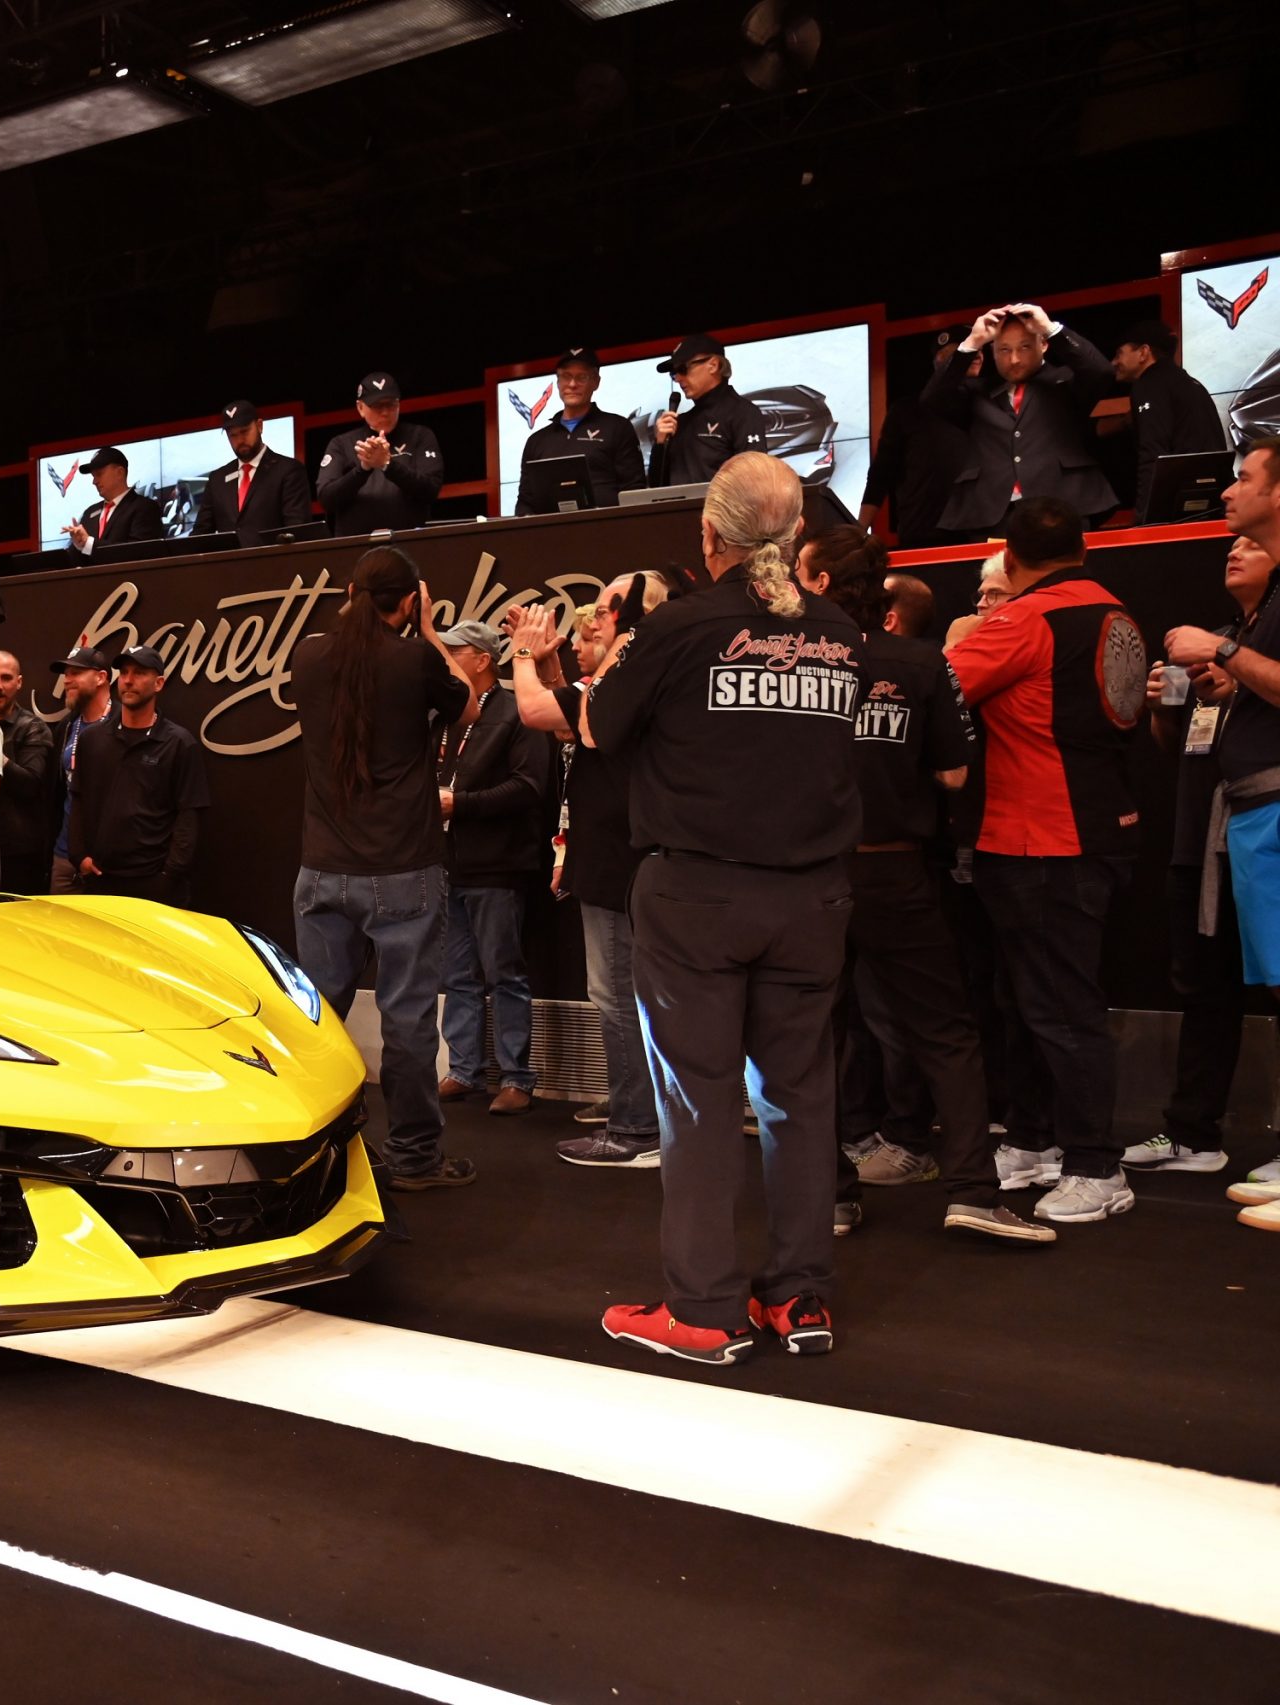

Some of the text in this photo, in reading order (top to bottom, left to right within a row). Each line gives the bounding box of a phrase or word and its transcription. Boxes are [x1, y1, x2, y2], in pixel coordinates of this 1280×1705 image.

[795, 665, 853, 682] AUCTION BLOCK
[715, 671, 856, 715] SECURITY
[873, 702, 899, 712] BLOCK
